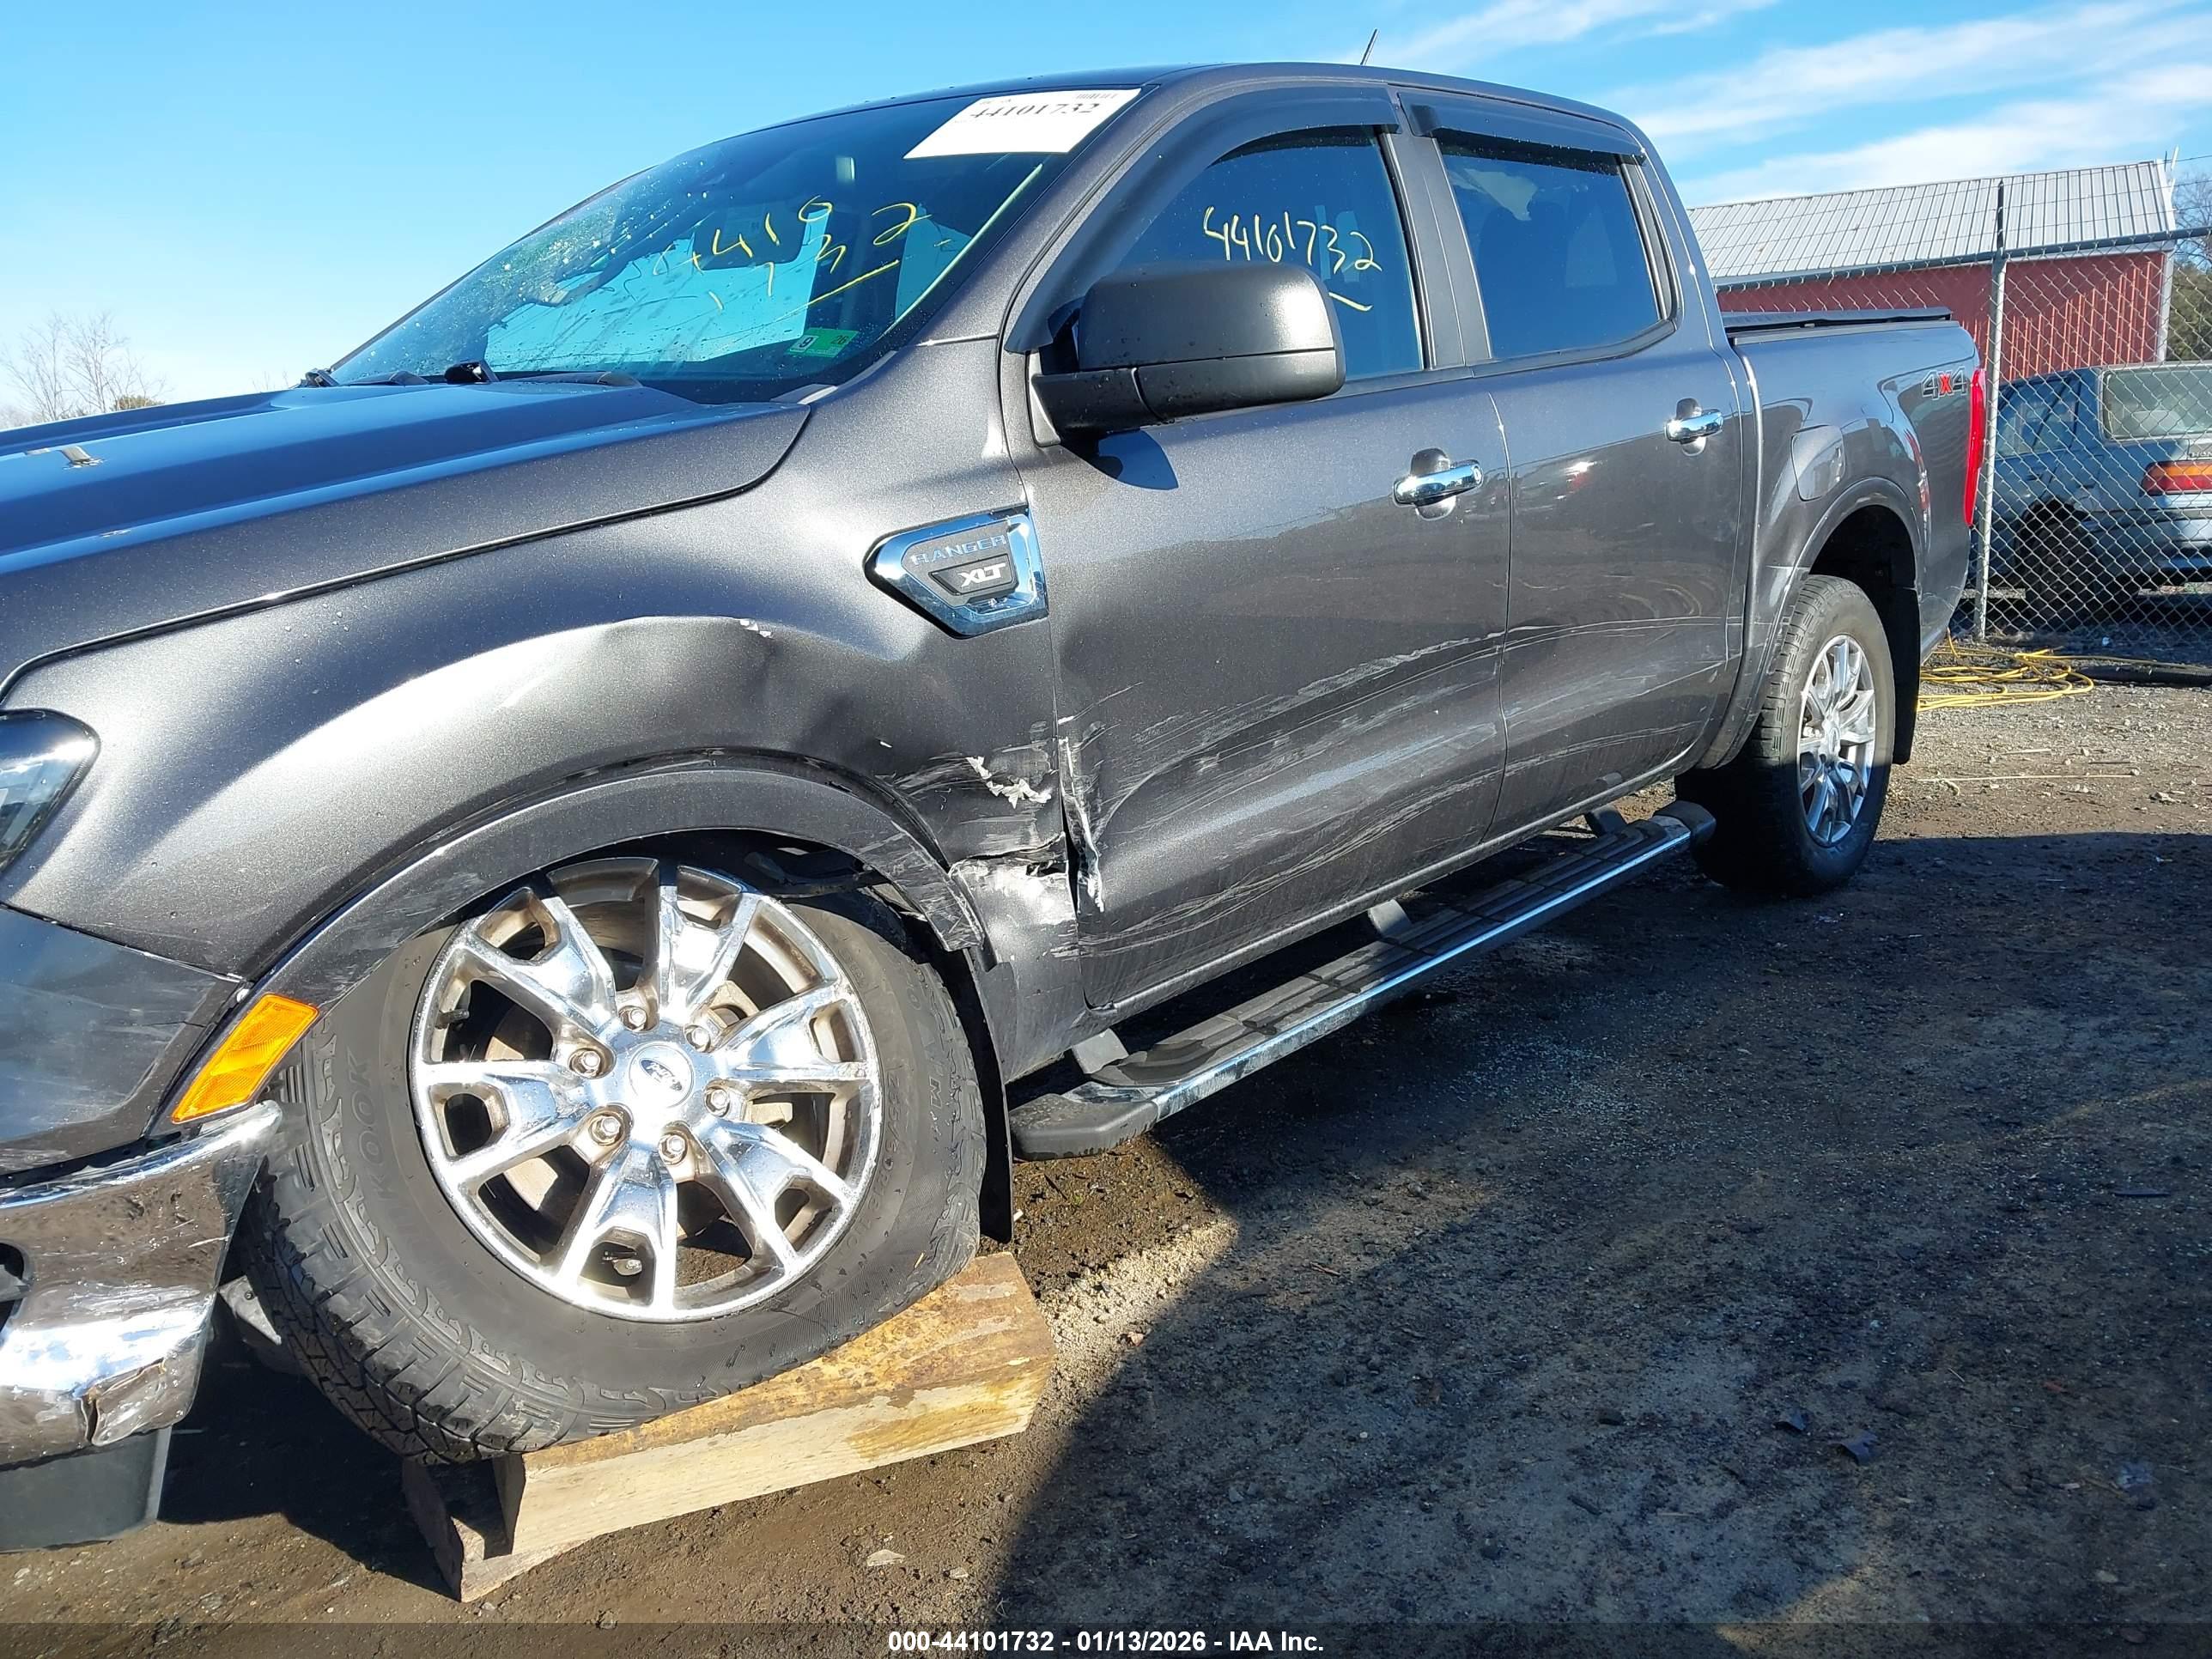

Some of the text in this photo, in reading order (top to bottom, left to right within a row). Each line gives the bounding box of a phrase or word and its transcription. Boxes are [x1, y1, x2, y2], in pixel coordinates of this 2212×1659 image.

[1202, 205, 1383, 274] 44101732
[910, 535, 1006, 566] RANGER
[957, 562, 1006, 588] XLT
